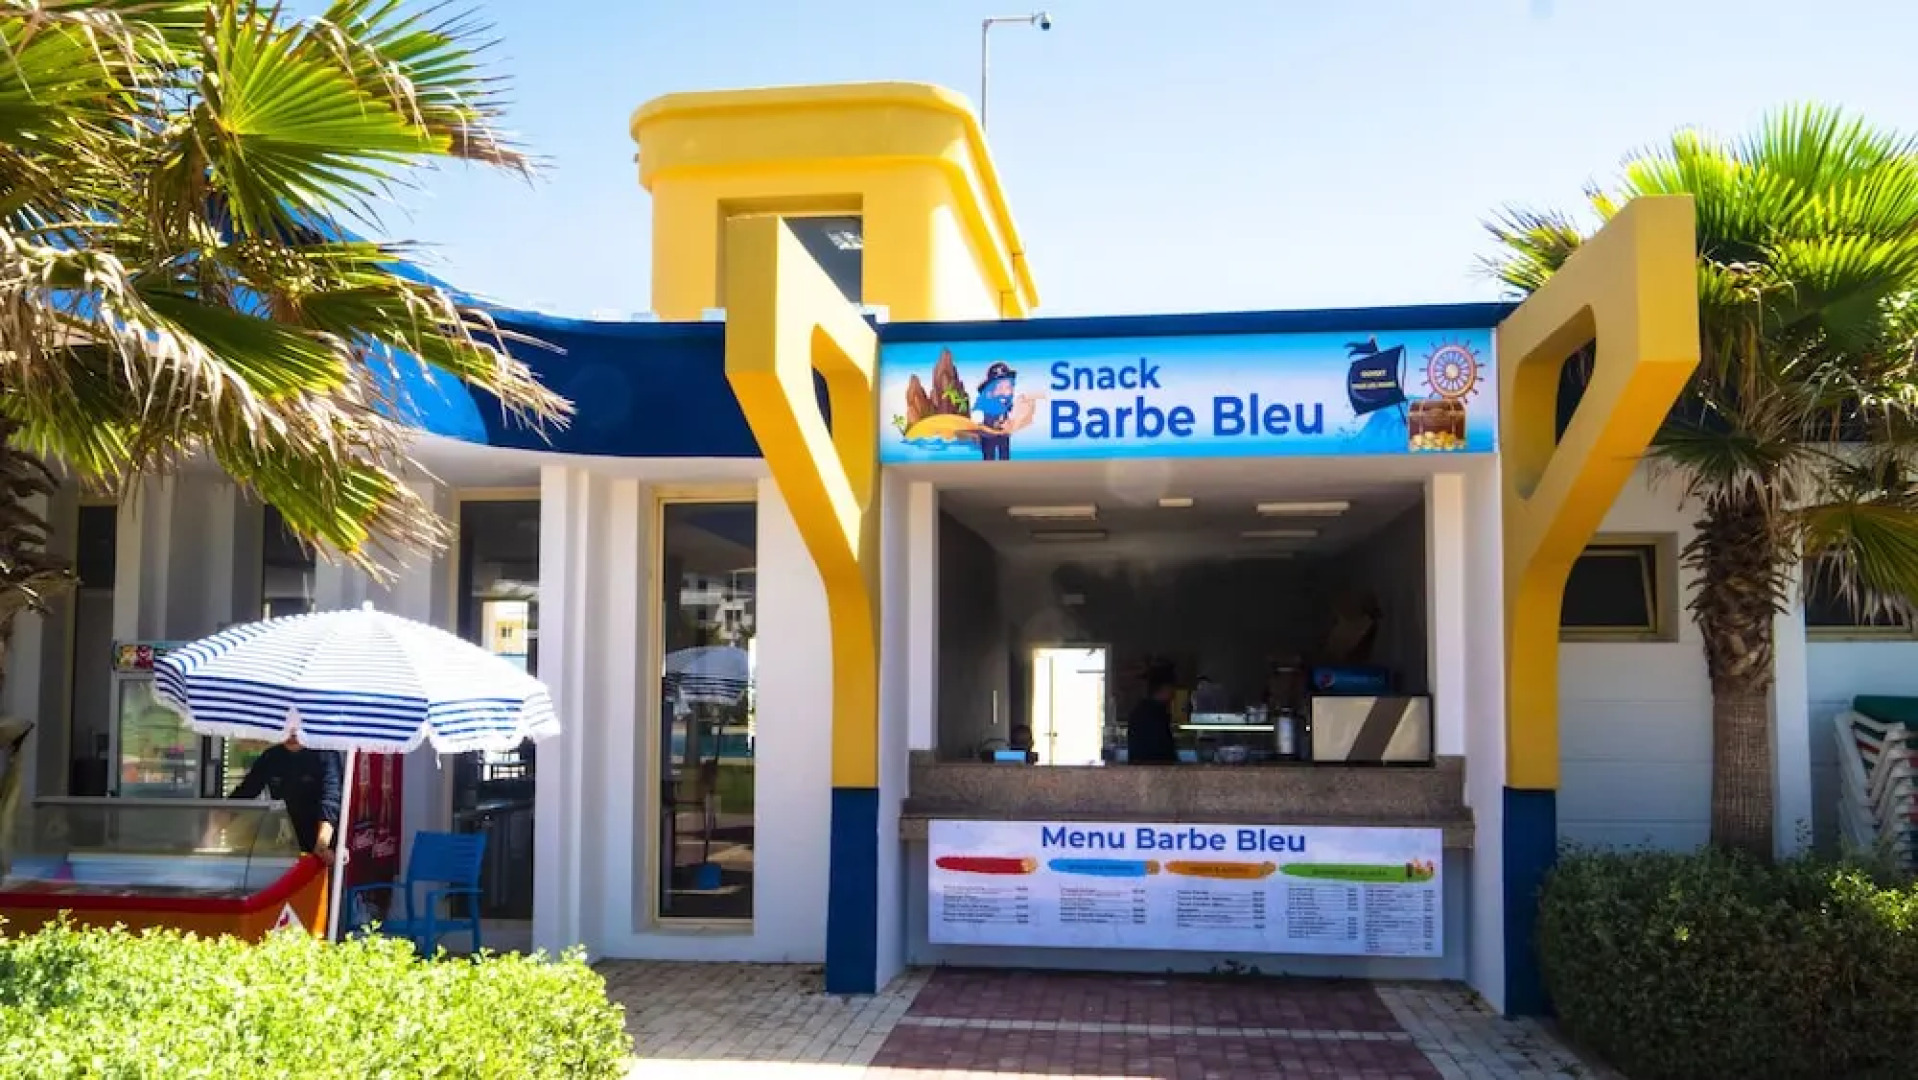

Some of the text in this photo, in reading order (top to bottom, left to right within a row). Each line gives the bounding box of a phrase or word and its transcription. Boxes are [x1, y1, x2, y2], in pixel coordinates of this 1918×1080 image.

[1050, 357, 1160, 391] Snack
[1050, 392, 1324, 440] Barbe Bleu
[1041, 826, 1306, 853] Menu Barbe Bleu
